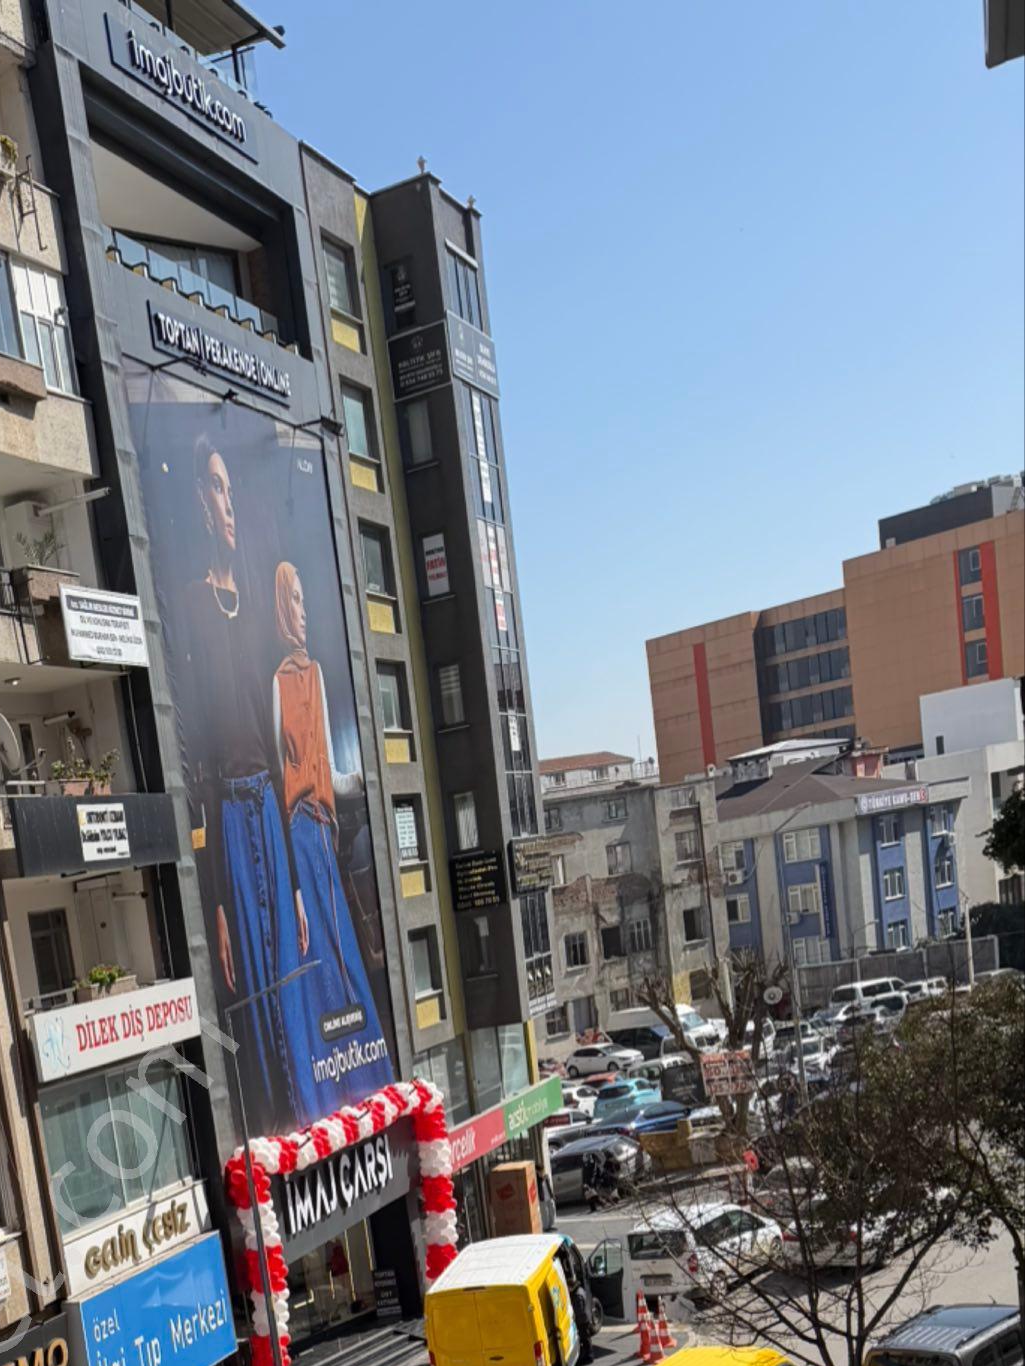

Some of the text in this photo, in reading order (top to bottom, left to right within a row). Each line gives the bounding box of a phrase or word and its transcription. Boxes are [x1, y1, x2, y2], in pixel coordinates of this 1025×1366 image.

[128, 30, 247, 143] imajbutik.com
[157, 313, 199, 354] TOPTAN
[205, 335, 258, 381] PERAKENDE
[76, 995, 193, 1052] DİLEK DİŞ DEPOSU
[311, 1038, 388, 1083] imajbutik.com
[451, 1127, 476, 1168] rçelik
[283, 1133, 394, 1235] İMAJ ÇARŞI
[93, 1309, 120, 1343] özel
[170, 1289, 228, 1353] Merkezi
